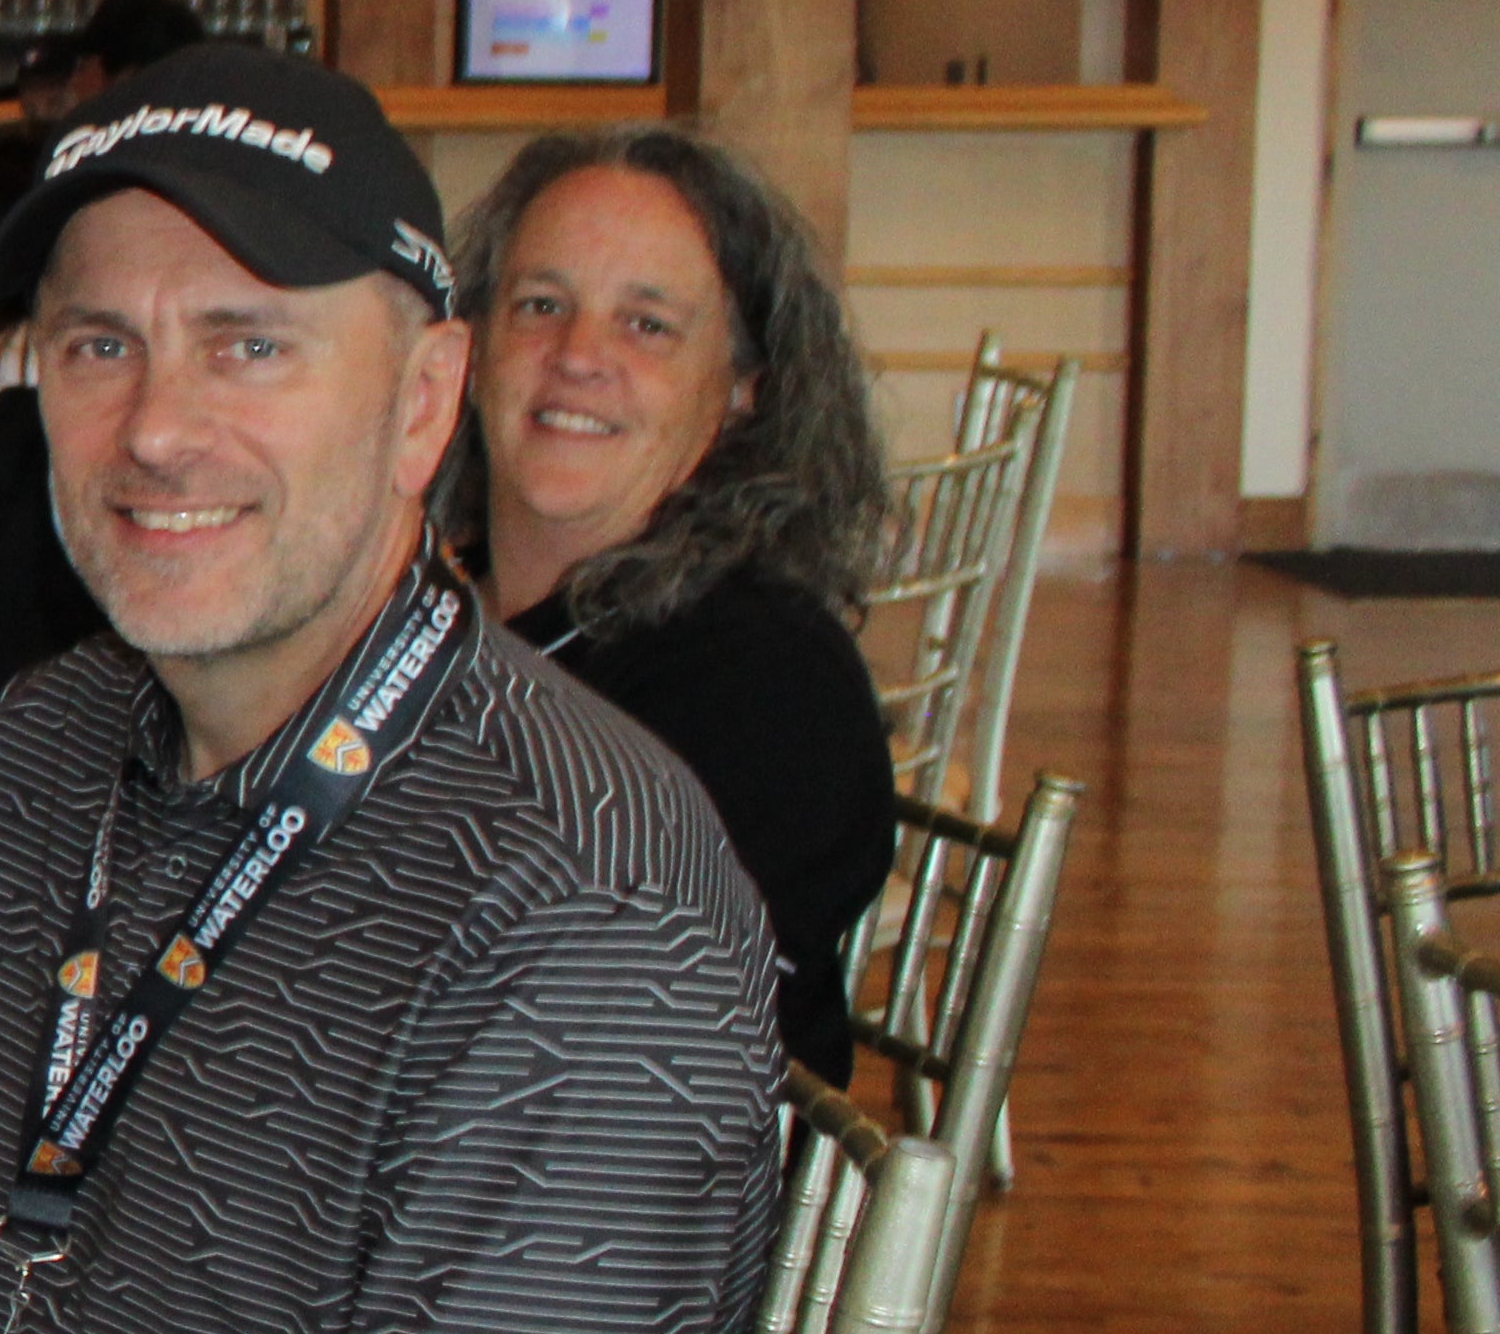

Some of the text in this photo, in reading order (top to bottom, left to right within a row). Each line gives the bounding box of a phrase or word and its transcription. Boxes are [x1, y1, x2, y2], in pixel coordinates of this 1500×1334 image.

[44, 102, 334, 181] TaylorMade
[347, 608, 423, 712] UNIVERSITY
[353, 589, 461, 732] WATERLOO
[188, 831, 257, 928] UNIVERSITY
[194, 804, 307, 950] WATERLOO
[58, 1015, 149, 1150] WATERLOO
